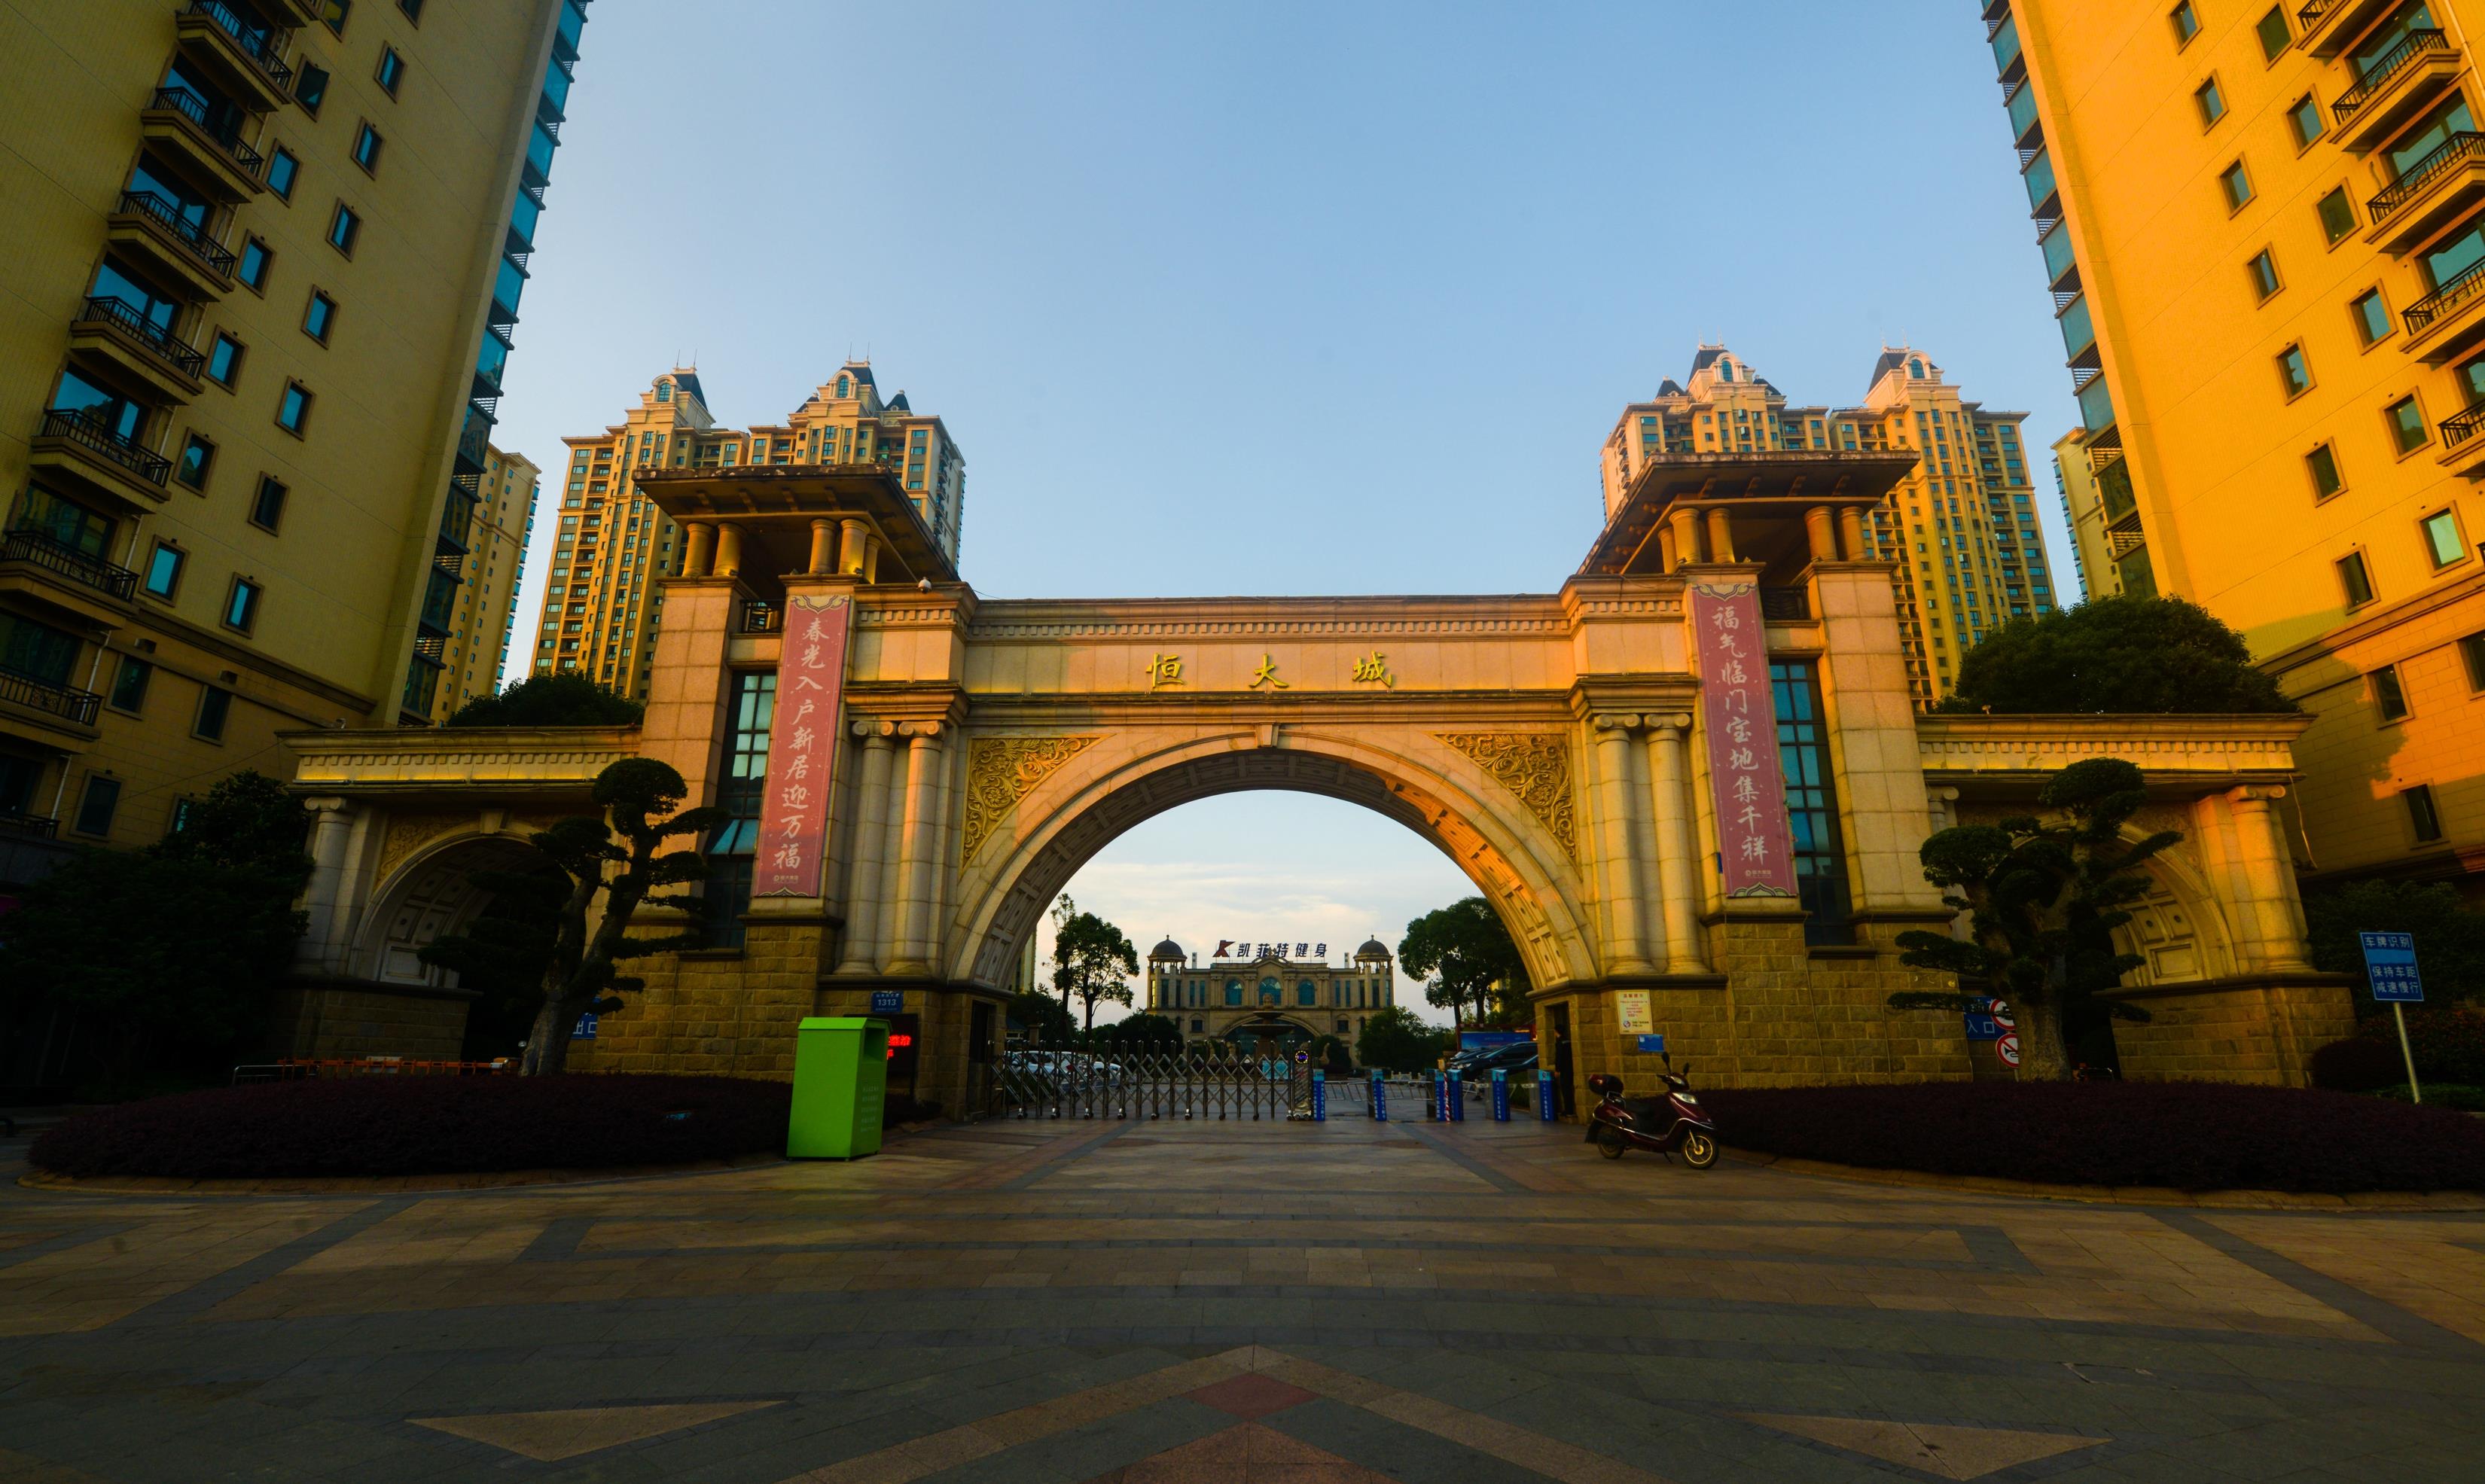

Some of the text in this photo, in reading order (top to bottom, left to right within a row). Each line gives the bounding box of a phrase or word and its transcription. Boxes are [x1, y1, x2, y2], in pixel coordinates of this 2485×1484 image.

[1145, 651, 1392, 688] 恒大城
[1712, 605, 1768, 865] 福气临门宝地集千祥
[773, 617, 829, 870] 春光入户新居迎万福
[2365, 936, 2410, 947] 车牌识别
[1237, 943, 1327, 958] 凯菲特健身
[2372, 966, 2417, 978] 保持车距
[2375, 981, 2419, 993] 减速慢行
[1967, 1019, 1995, 1035] 入口
